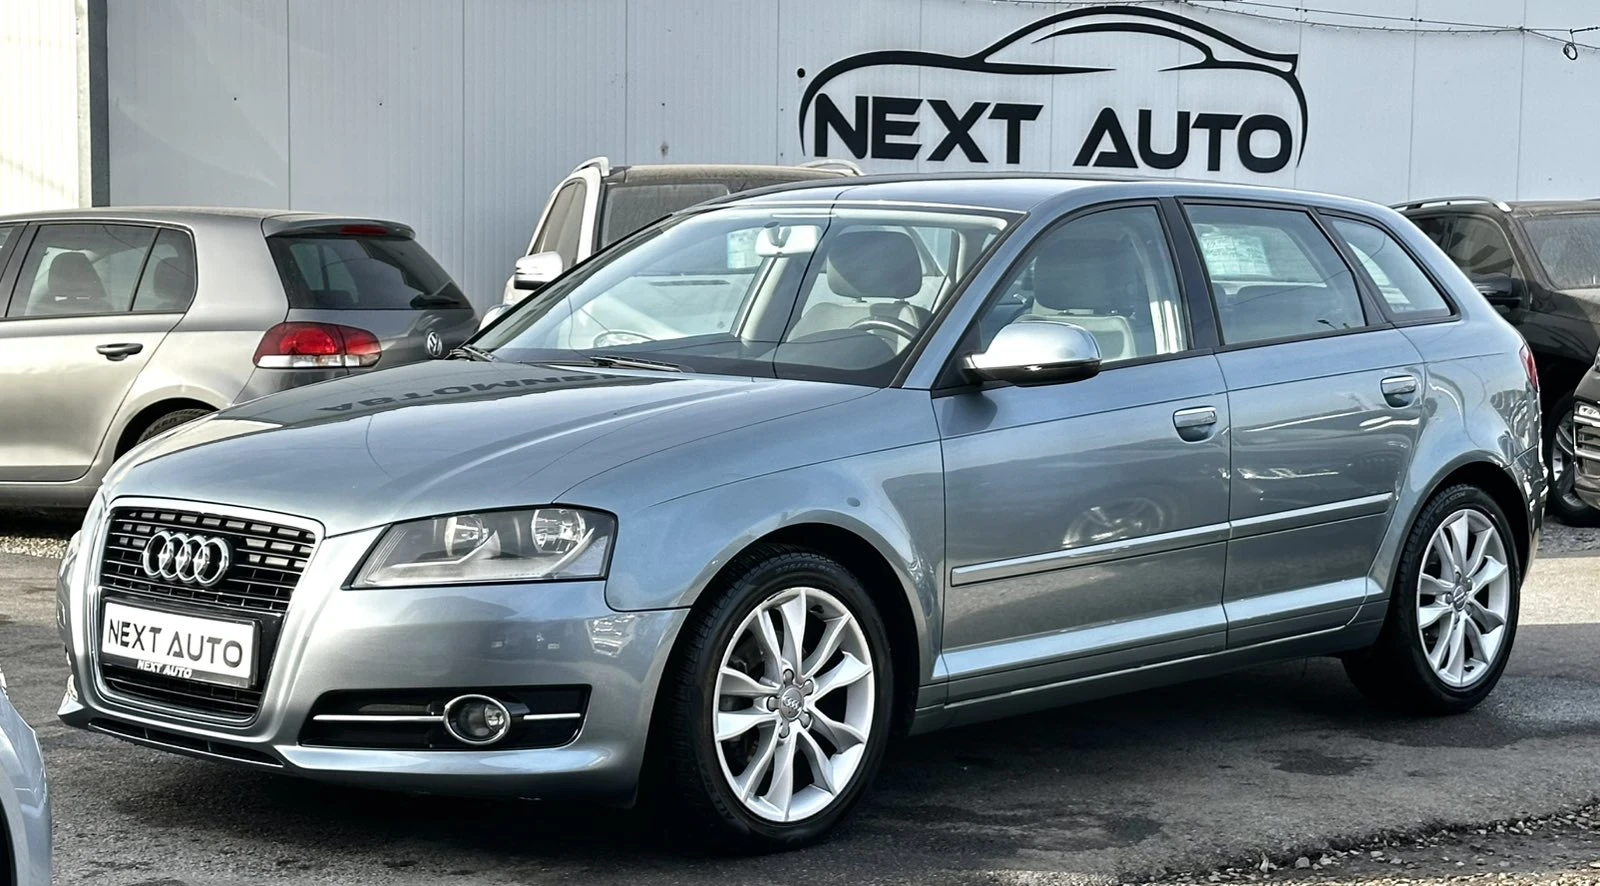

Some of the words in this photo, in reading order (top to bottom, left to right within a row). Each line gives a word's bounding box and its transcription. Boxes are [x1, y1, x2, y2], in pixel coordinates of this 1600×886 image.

[814, 92, 1043, 164] NEXT
[1073, 107, 1292, 174] AUTO
[108, 618, 162, 653] NEXT
[166, 631, 243, 668] AUTO
[136, 660, 163, 674] NEXT
[162, 664, 193, 679] AUTO
